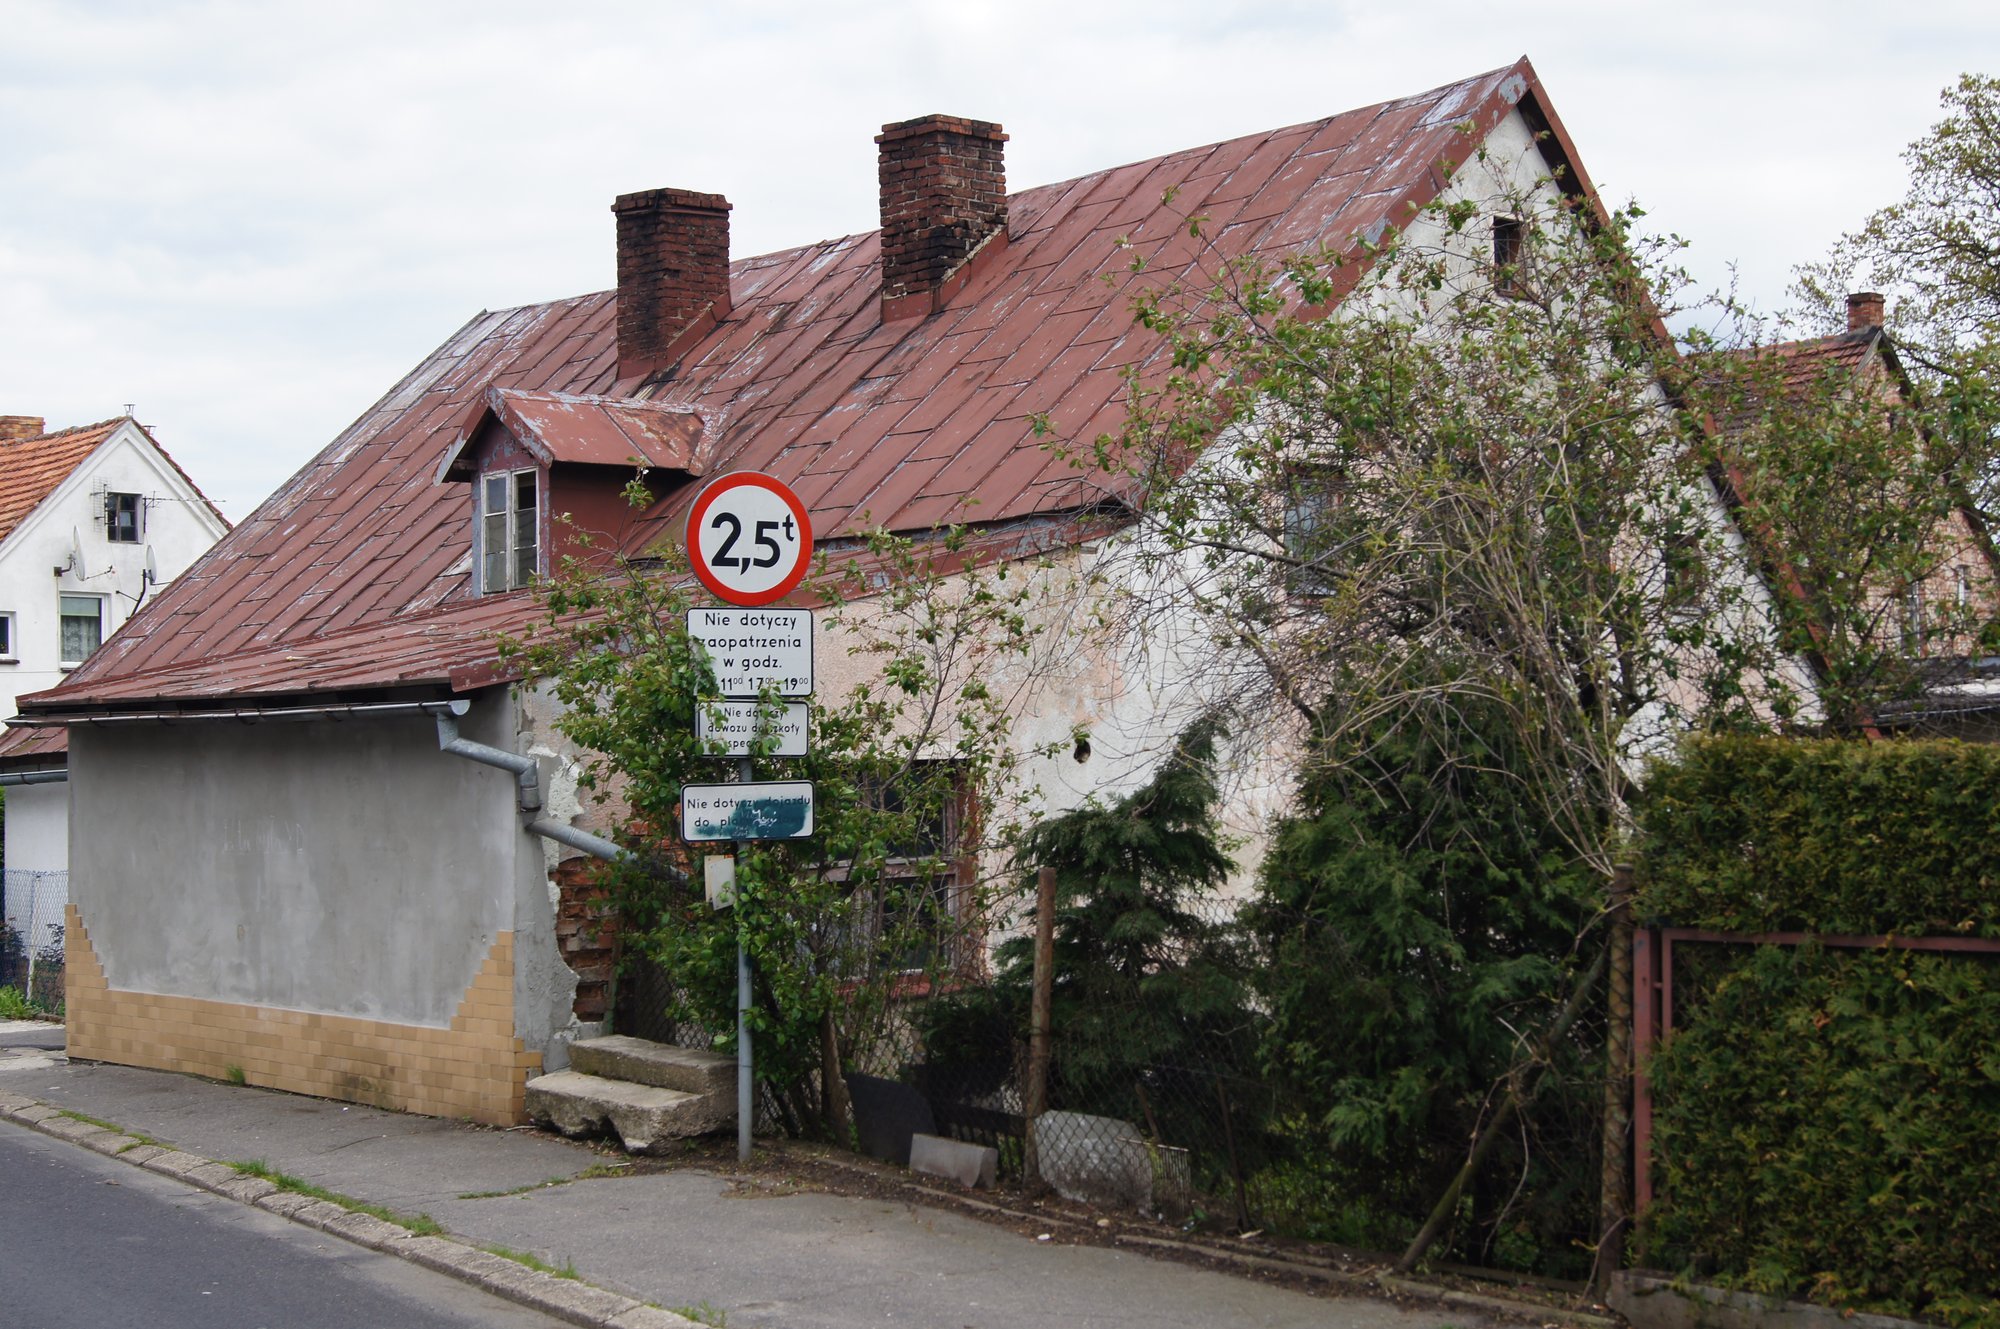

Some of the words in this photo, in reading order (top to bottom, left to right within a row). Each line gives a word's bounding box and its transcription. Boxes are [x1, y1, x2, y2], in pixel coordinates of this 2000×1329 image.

[705, 612, 731, 626] Nie
[740, 613, 797, 630] dotyczy
[702, 635, 801, 651] zaopatrzenia
[723, 658, 735, 667] w
[741, 655, 782, 671] godz.
[724, 707, 742, 718] Nie
[746, 707, 784, 720] dotczy
[707, 722, 747, 733] dowozu
[770, 723, 800, 735] zkoły
[687, 798, 708, 809] Nie
[694, 817, 710, 827] do
